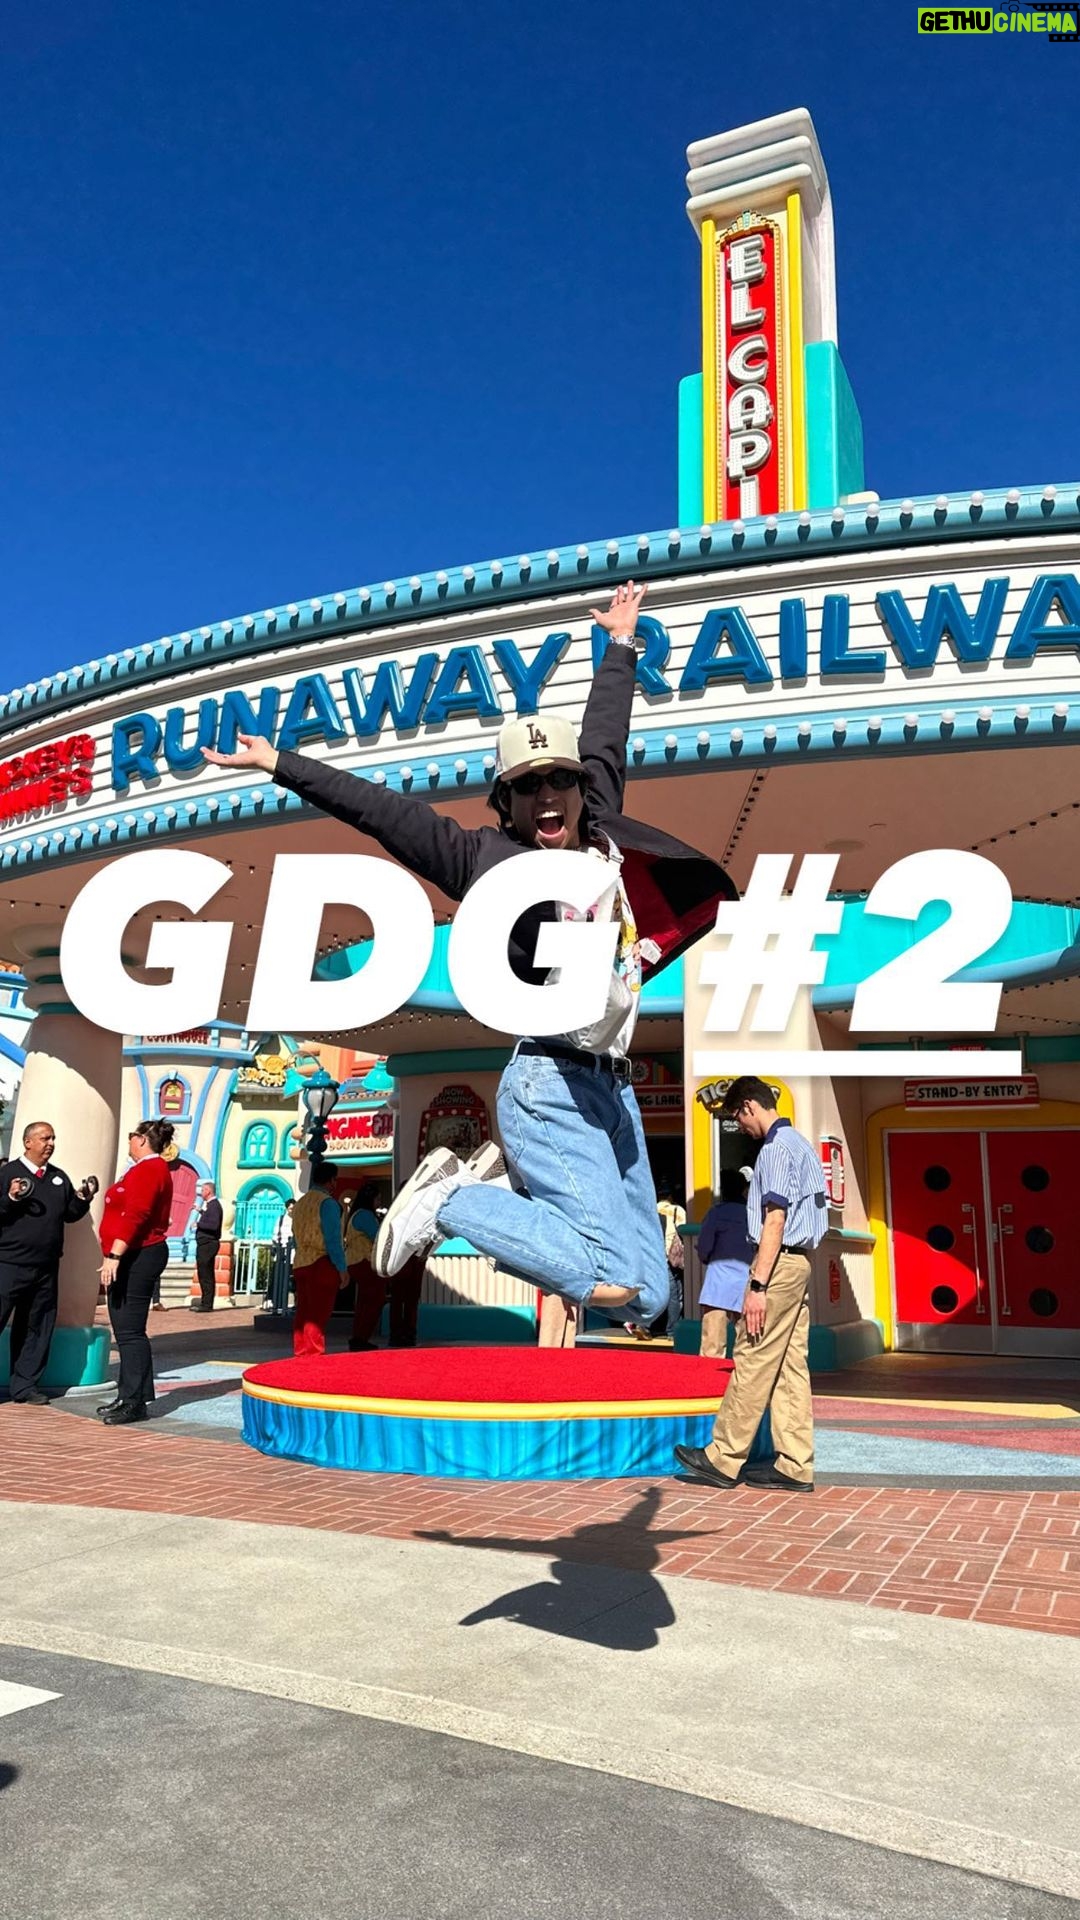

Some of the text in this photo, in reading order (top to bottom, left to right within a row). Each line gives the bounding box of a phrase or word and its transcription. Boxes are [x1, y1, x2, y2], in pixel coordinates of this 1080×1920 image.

[112, 573, 1080, 791] RUNAWAY RAILWA
[526, 723, 549, 750] LA
[917, 1084, 1023, 1099] STAND-BY ENTRY
